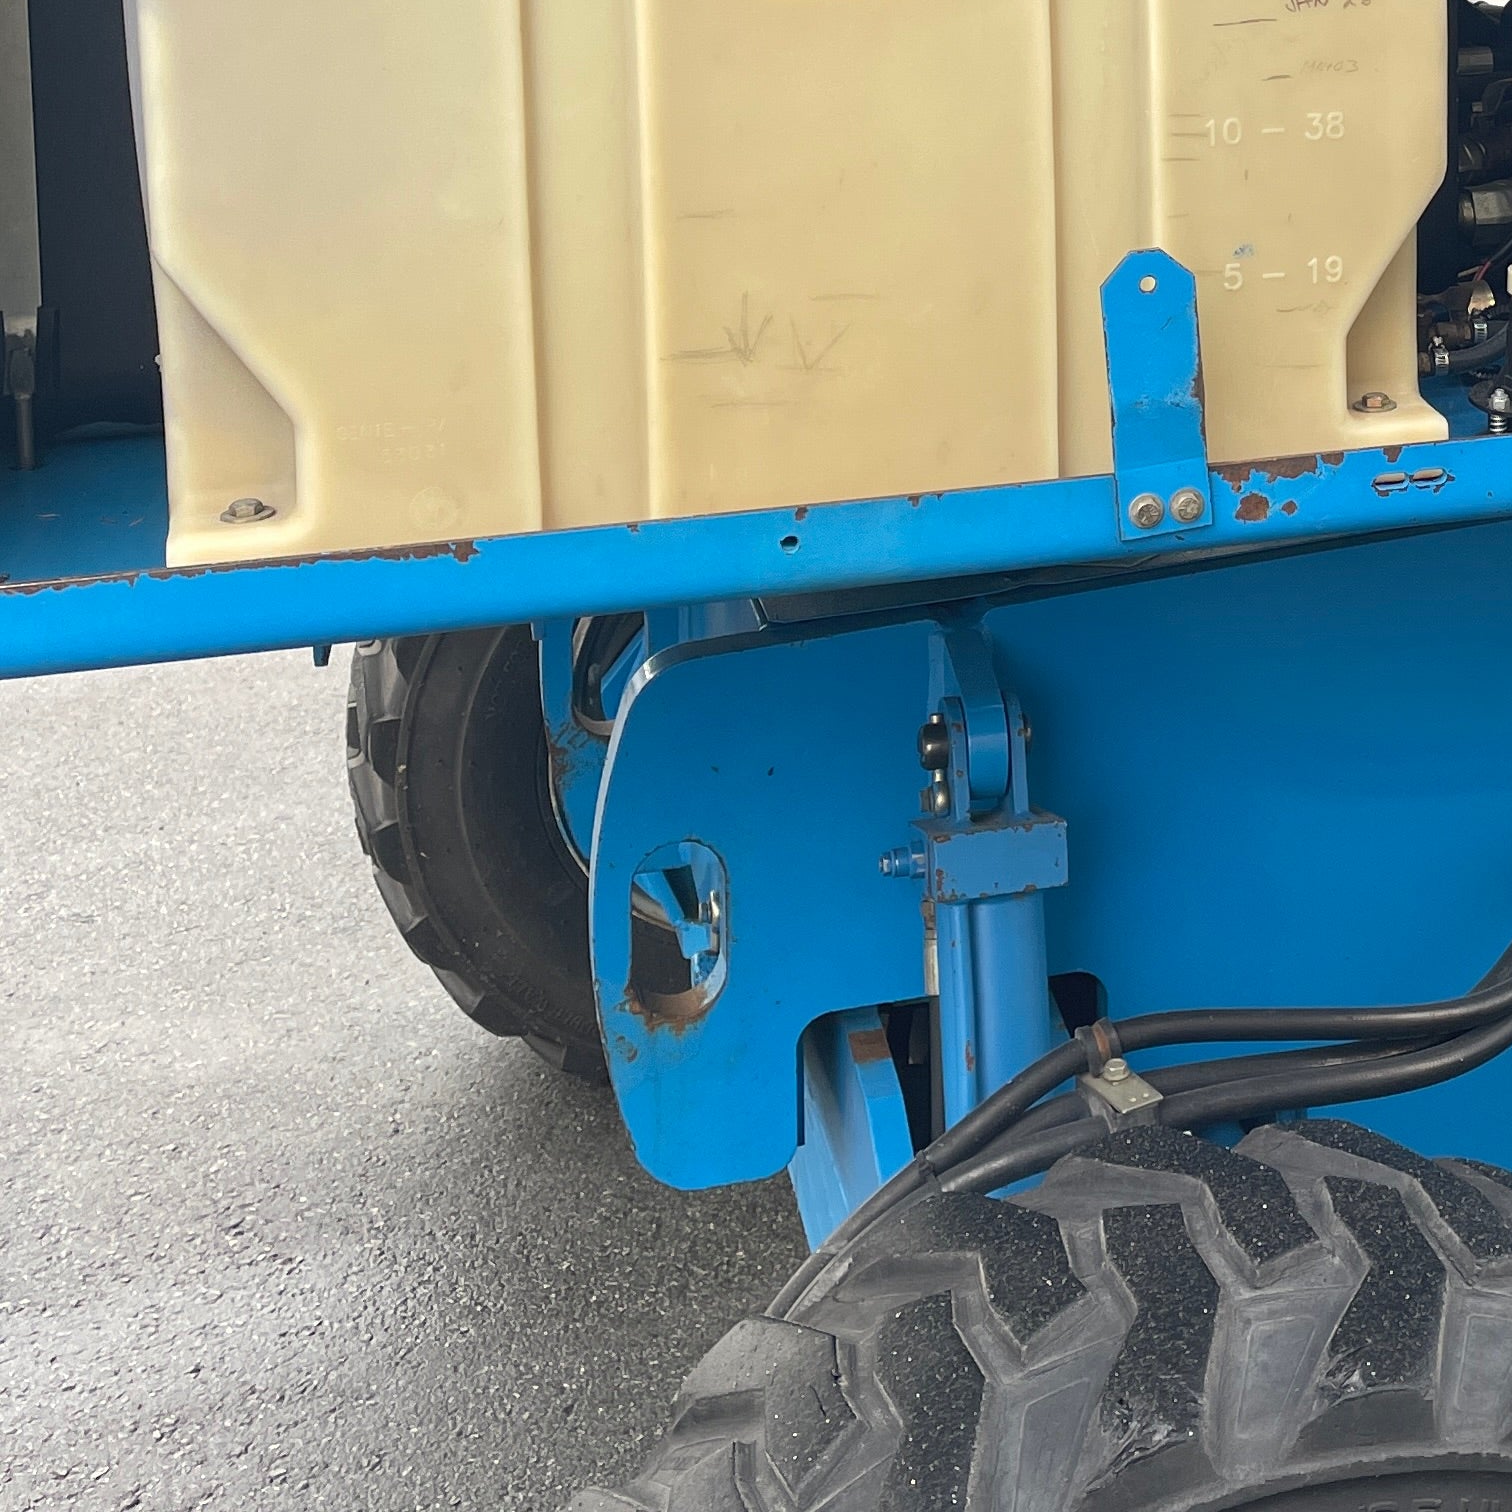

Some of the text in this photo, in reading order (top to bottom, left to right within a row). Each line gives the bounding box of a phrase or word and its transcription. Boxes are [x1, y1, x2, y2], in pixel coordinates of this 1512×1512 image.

[1203, 111, 1346, 147] 10 38
[1222, 255, 1344, 291] 5 19
